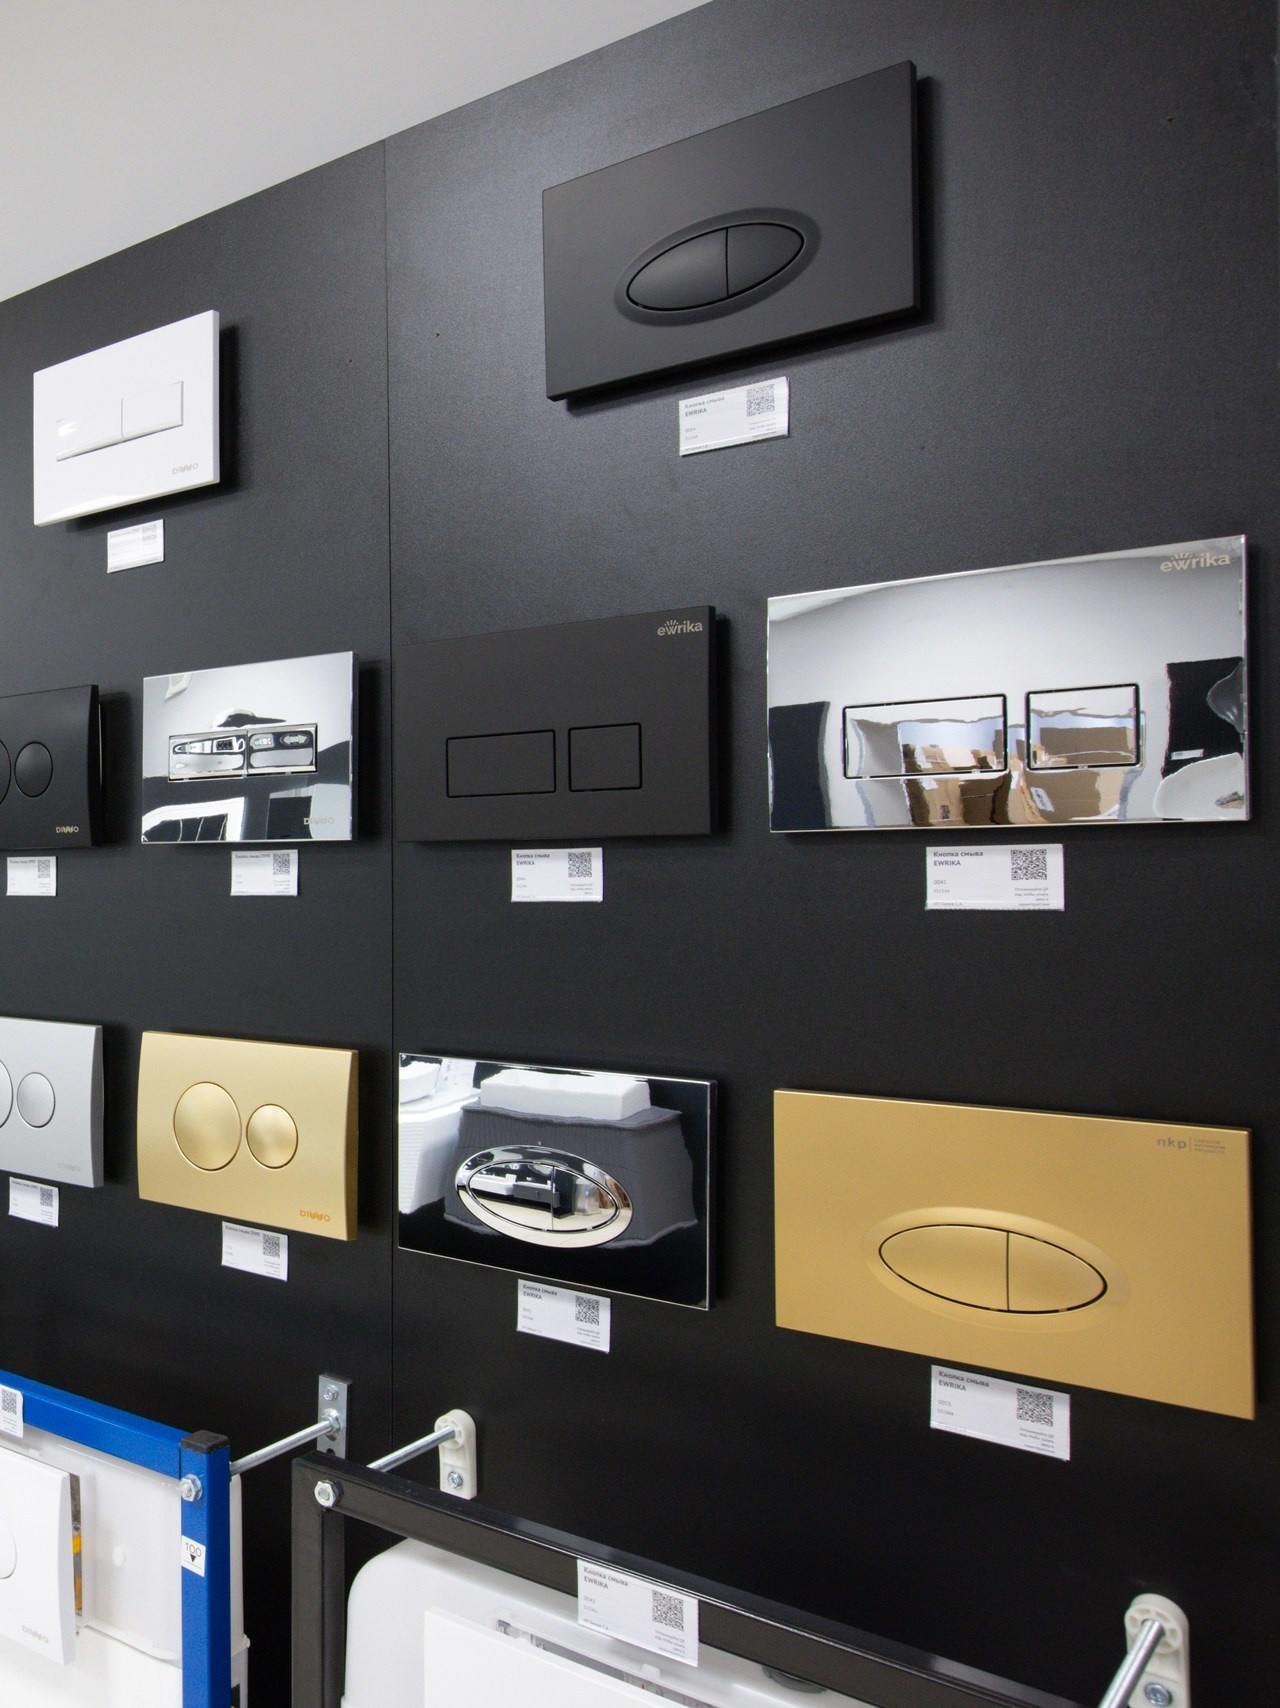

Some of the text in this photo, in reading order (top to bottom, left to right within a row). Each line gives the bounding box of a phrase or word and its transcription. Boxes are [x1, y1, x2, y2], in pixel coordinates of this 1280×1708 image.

[685, 407, 707, 417] EWRIKA
[1160, 552, 1231, 572] ewrika
[657, 620, 703, 636] ewrika
[933, 859, 961, 867] EWRIKA
[523, 1291, 542, 1300] EWRIKA
[938, 1371, 989, 1387] Кнопка смыва
[938, 1380, 967, 1392] EWRIKA
[185, 1542, 202, 1558] 100
[583, 1567, 628, 1587] Кнопка смыва
[583, 1576, 608, 1589] EWRIKA
